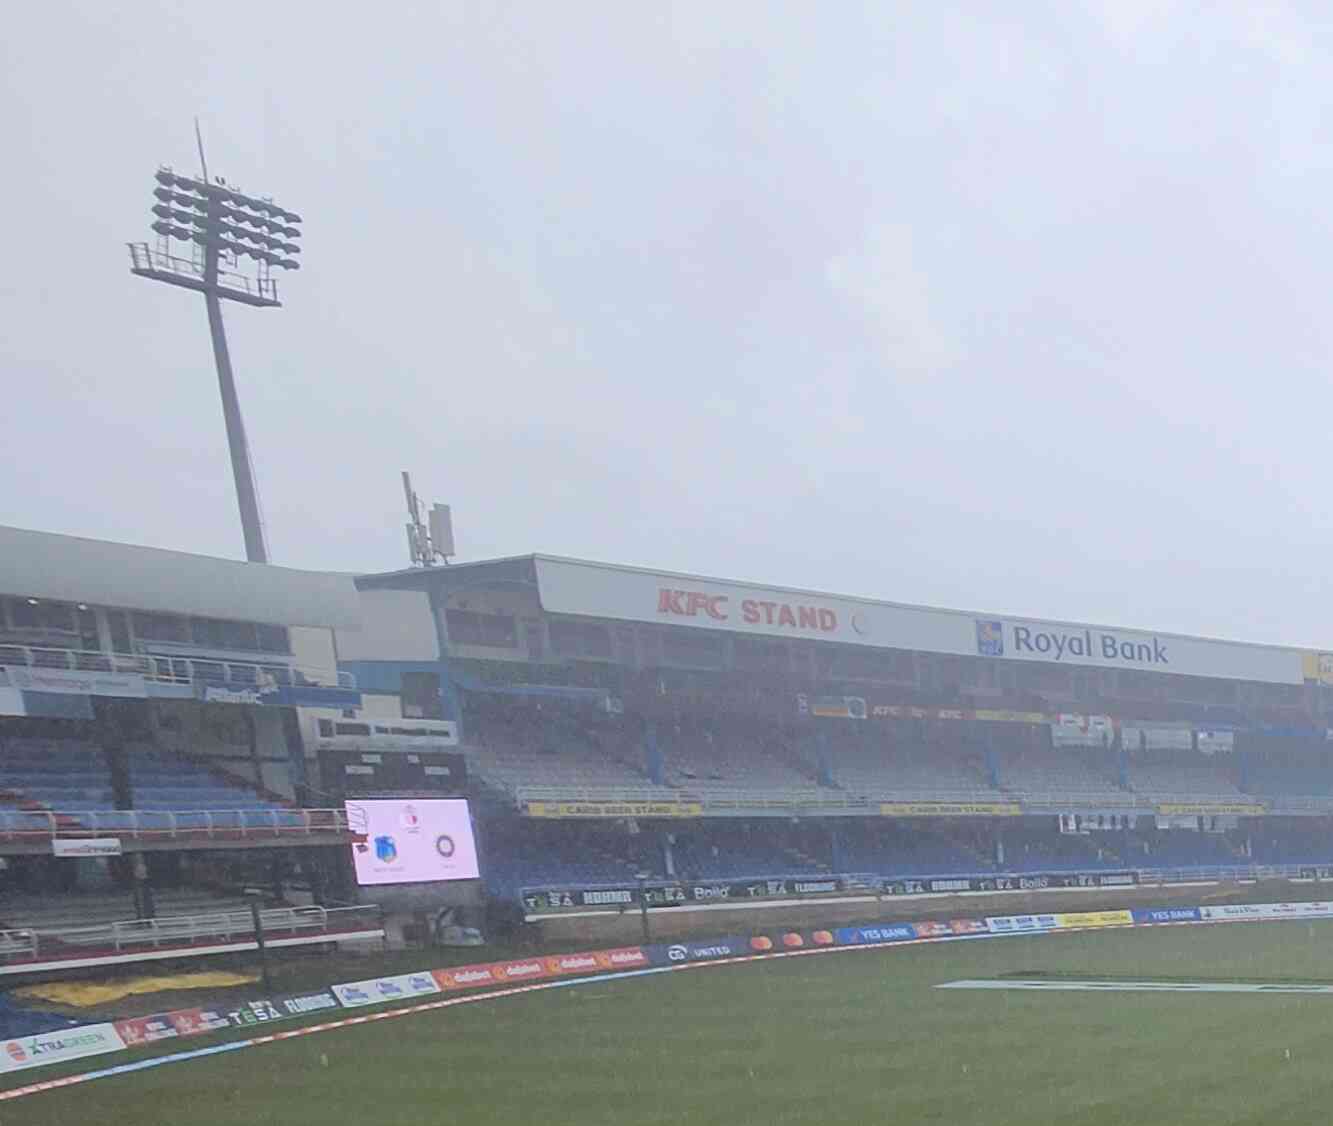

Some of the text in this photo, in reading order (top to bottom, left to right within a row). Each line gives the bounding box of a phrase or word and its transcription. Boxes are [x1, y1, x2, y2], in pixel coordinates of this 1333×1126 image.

[657, 588, 838, 632] KFC STAND
[1013, 627, 1169, 664] Royal Bank
[1152, 910, 1195, 921] YES BANK
[861, 928, 910, 940] YES BANK
[695, 946, 730, 958] UNITED
